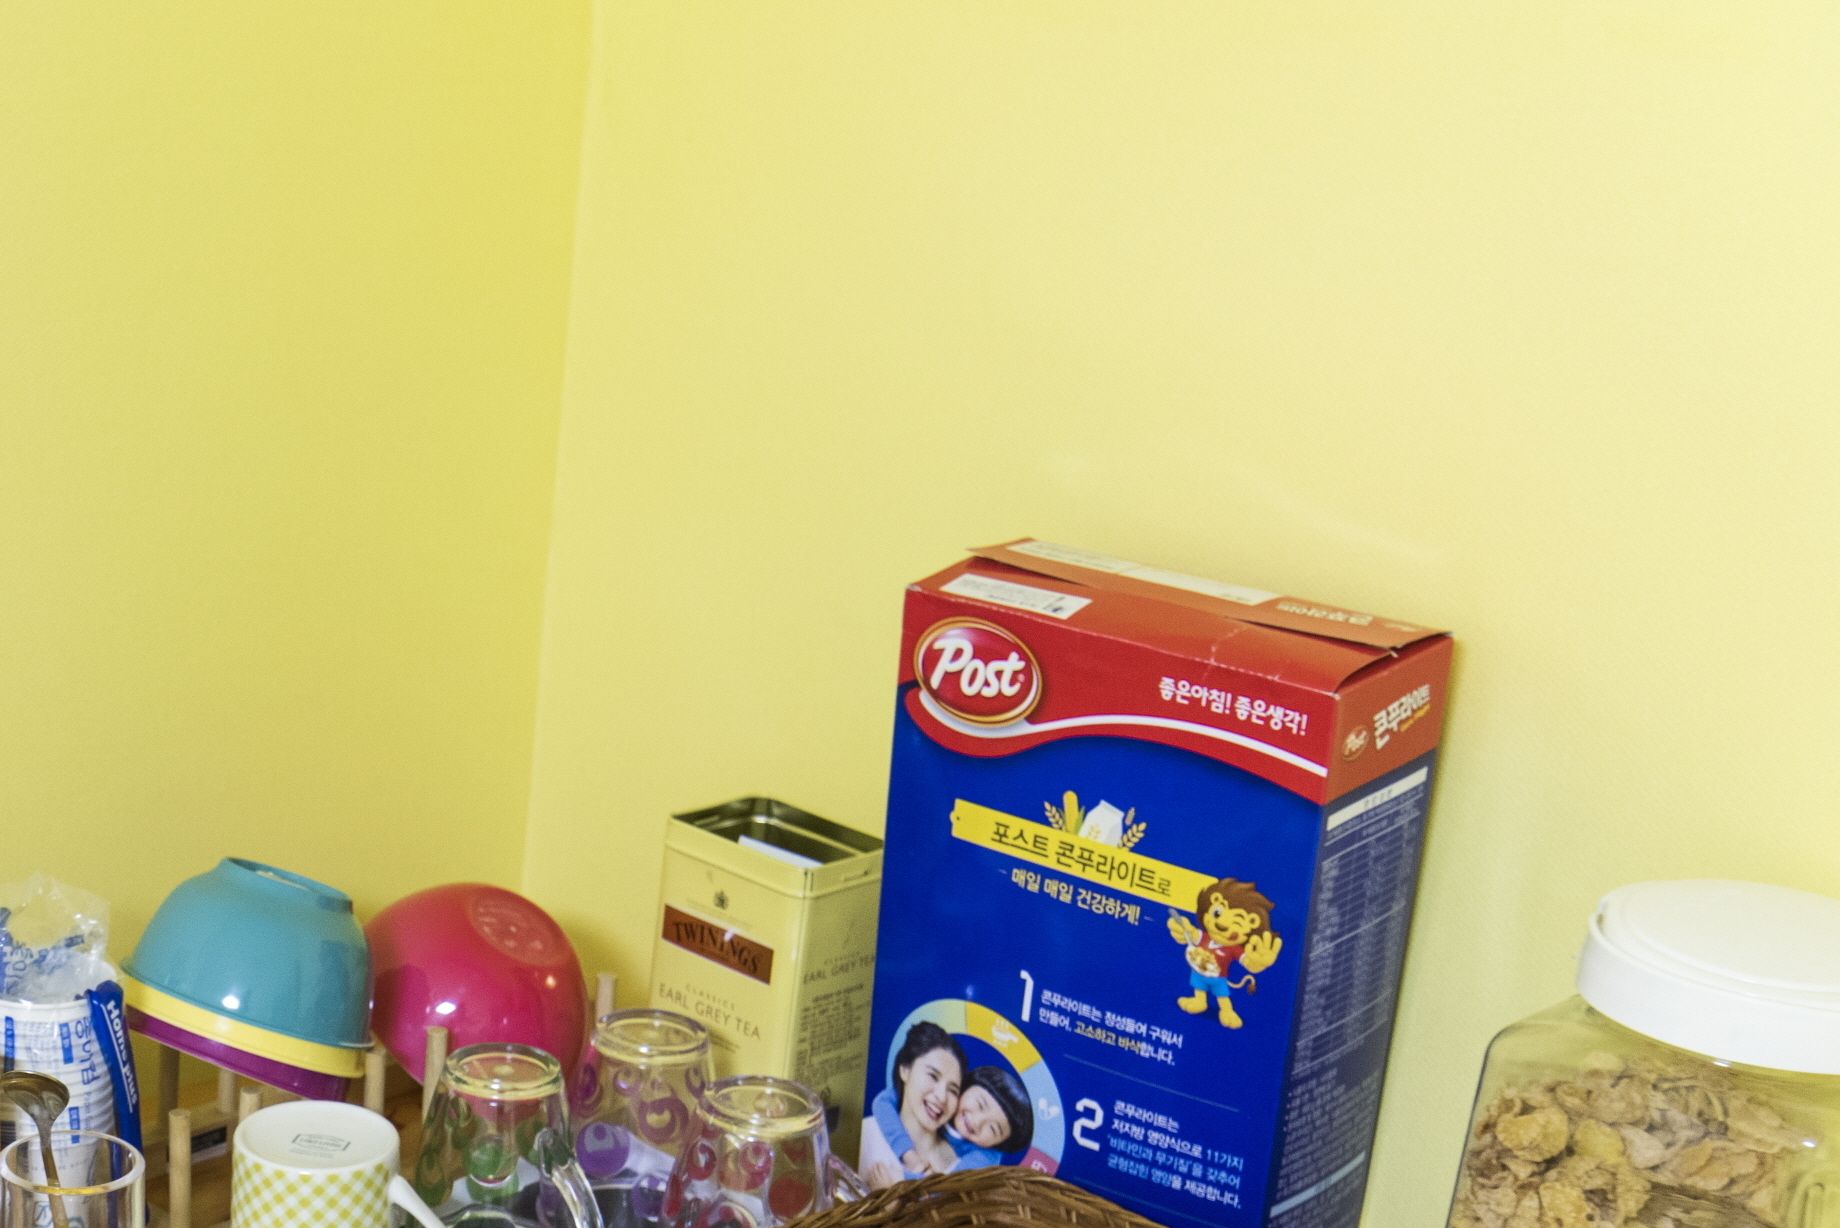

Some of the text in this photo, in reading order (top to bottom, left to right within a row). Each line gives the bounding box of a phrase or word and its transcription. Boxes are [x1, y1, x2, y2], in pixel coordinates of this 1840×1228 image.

[930, 637, 1026, 697] Post
[1159, 676, 1308, 736] 좋은아침! 좋은생각!
[991, 822, 1171, 897] 포스트 콘푸라이트로
[1012, 867, 1140, 926] 매일 매일 건강하게!
[674, 921, 760, 974] TWININGS
[659, 983, 760, 1040] EARL GREY TEA
[1020, 969, 1034, 1022] 1
[1041, 989, 1103, 1022] 콘푸라이트는
[1104, 1011, 1147, 1037] 정성들여
[1074, 1021, 1116, 1046] 고소하고
[1118, 1035, 1175, 1066] 바삭합니다.
[1072, 1098, 1104, 1152] 2
[1114, 1100, 1179, 1133] 콘푸라이트는
[1207, 1148, 1243, 1171] 11가지
